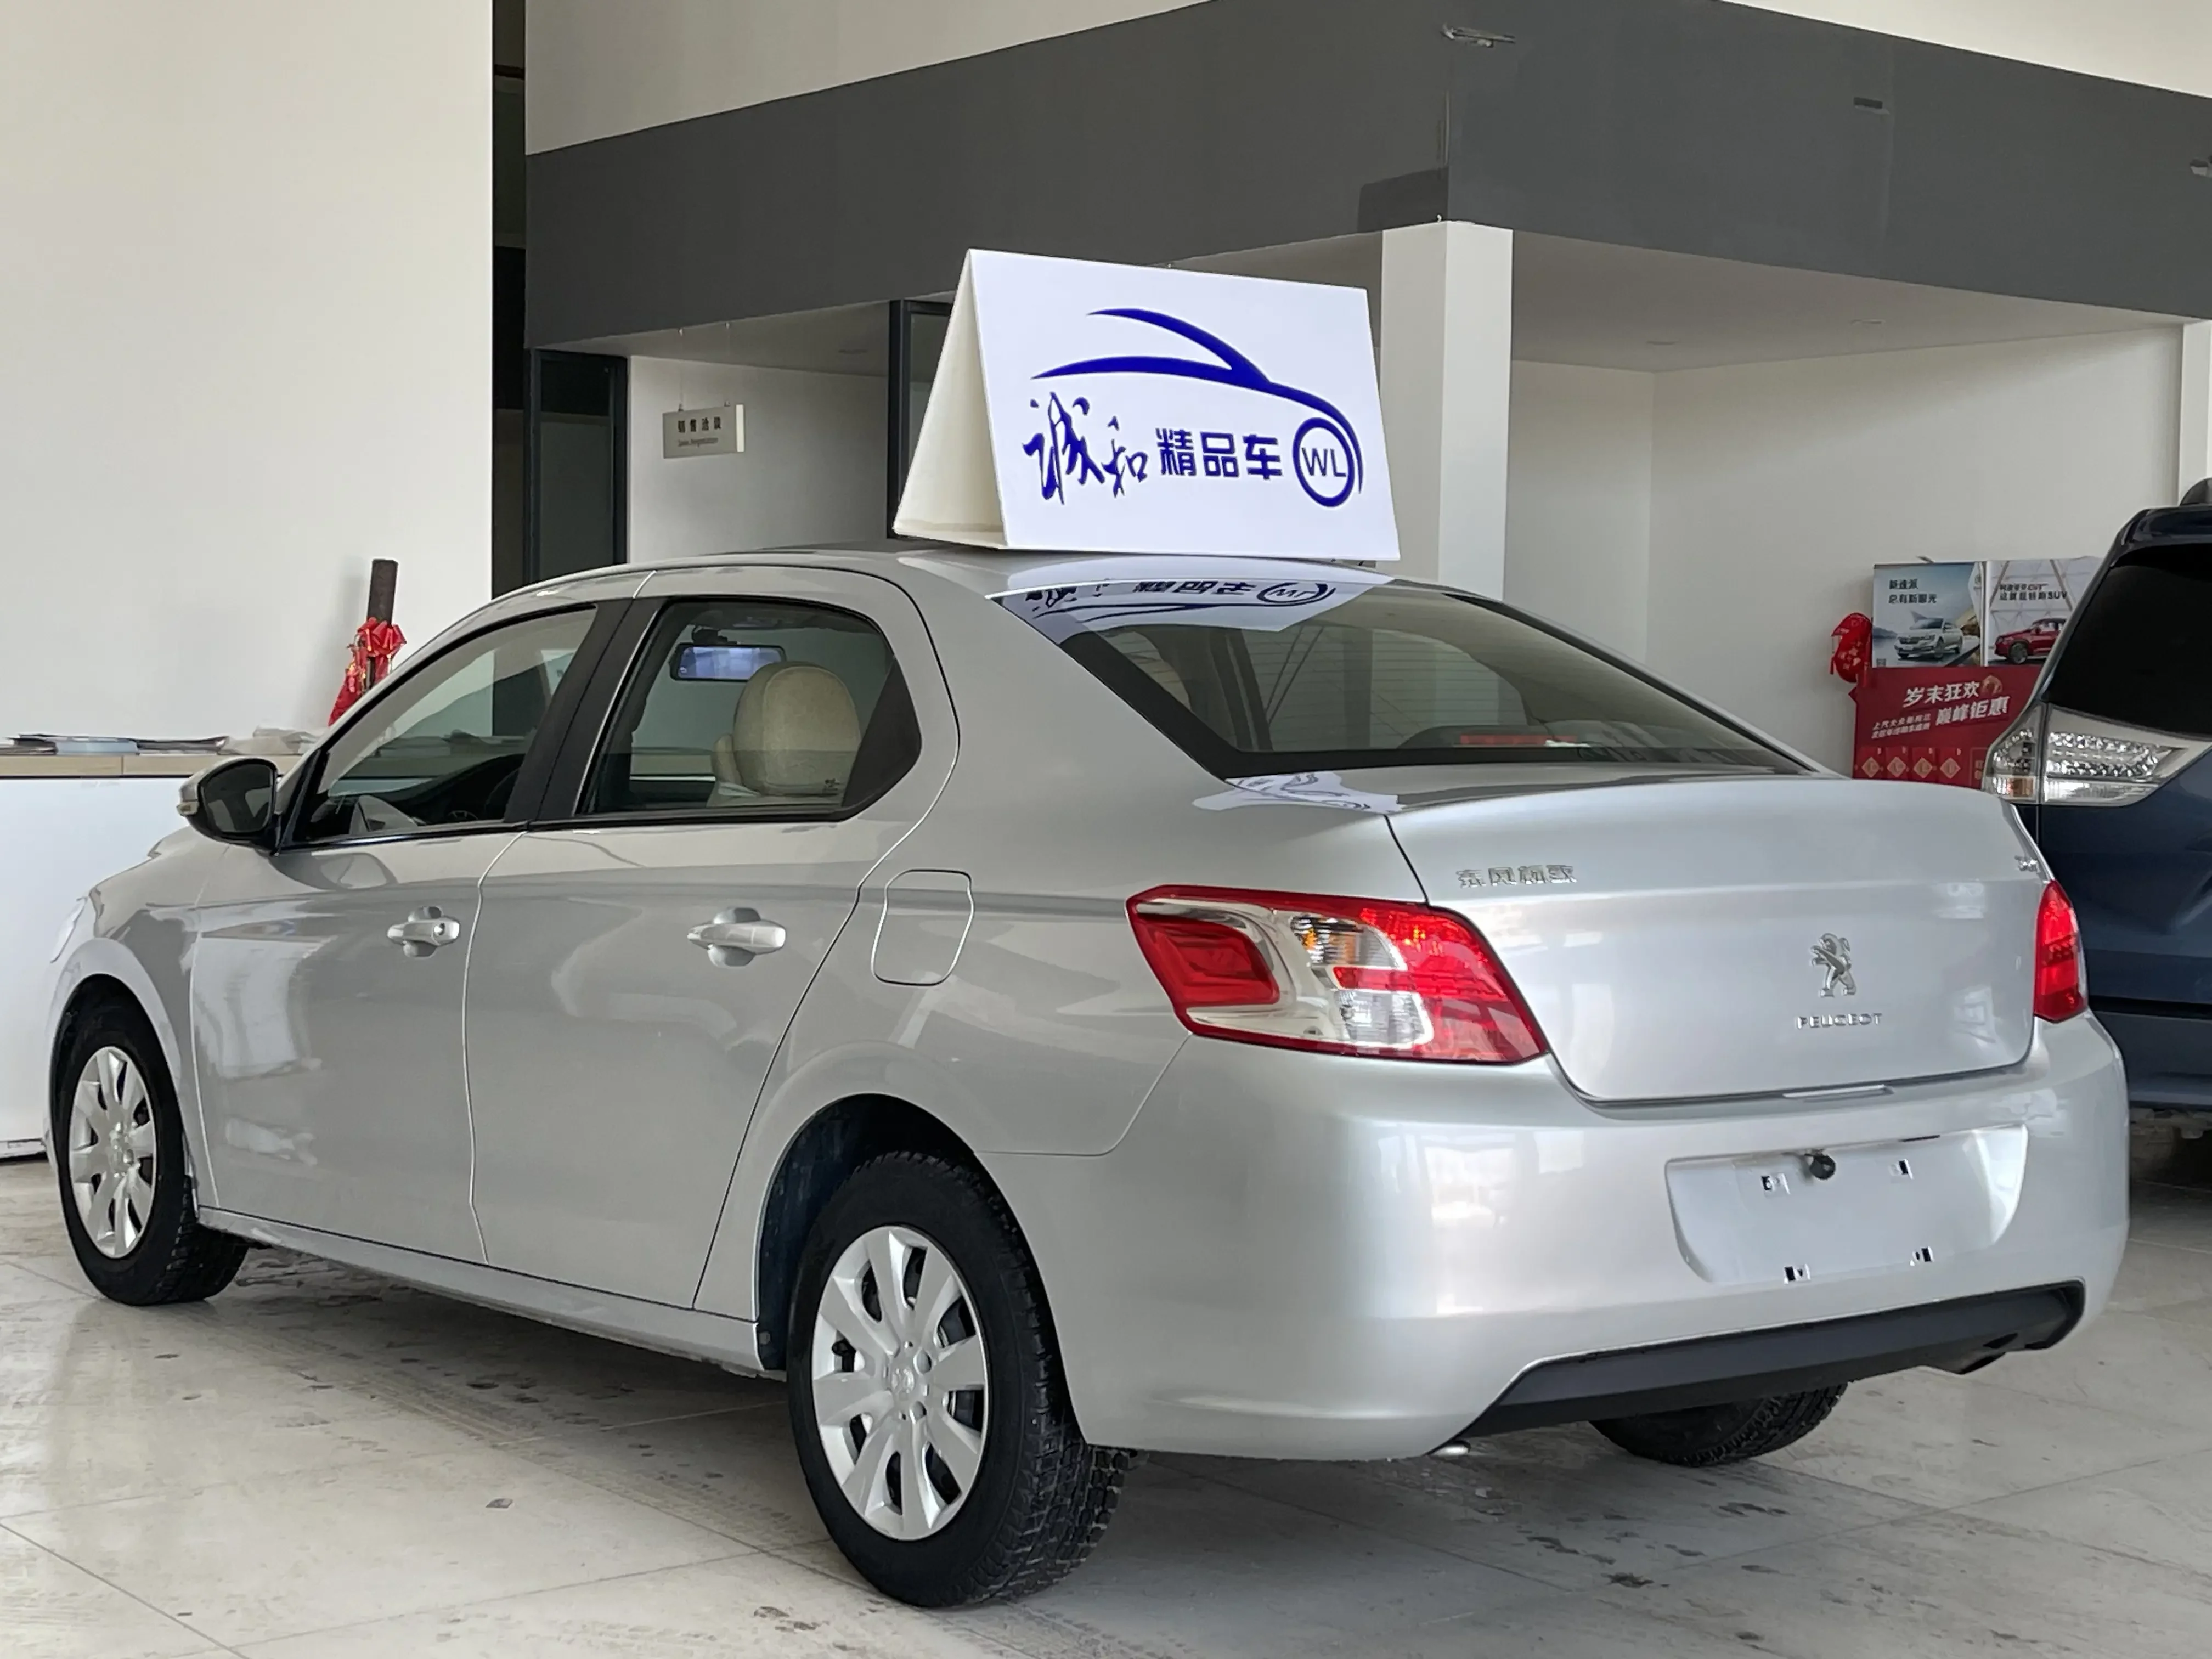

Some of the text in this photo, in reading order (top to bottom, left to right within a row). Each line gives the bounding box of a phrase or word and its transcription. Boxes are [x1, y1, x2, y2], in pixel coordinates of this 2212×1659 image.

[1301, 447, 1347, 477] WL
[1902, 681, 1980, 708] 岁末狂欢
[1796, 1013, 1882, 1030] PEUGEOT
